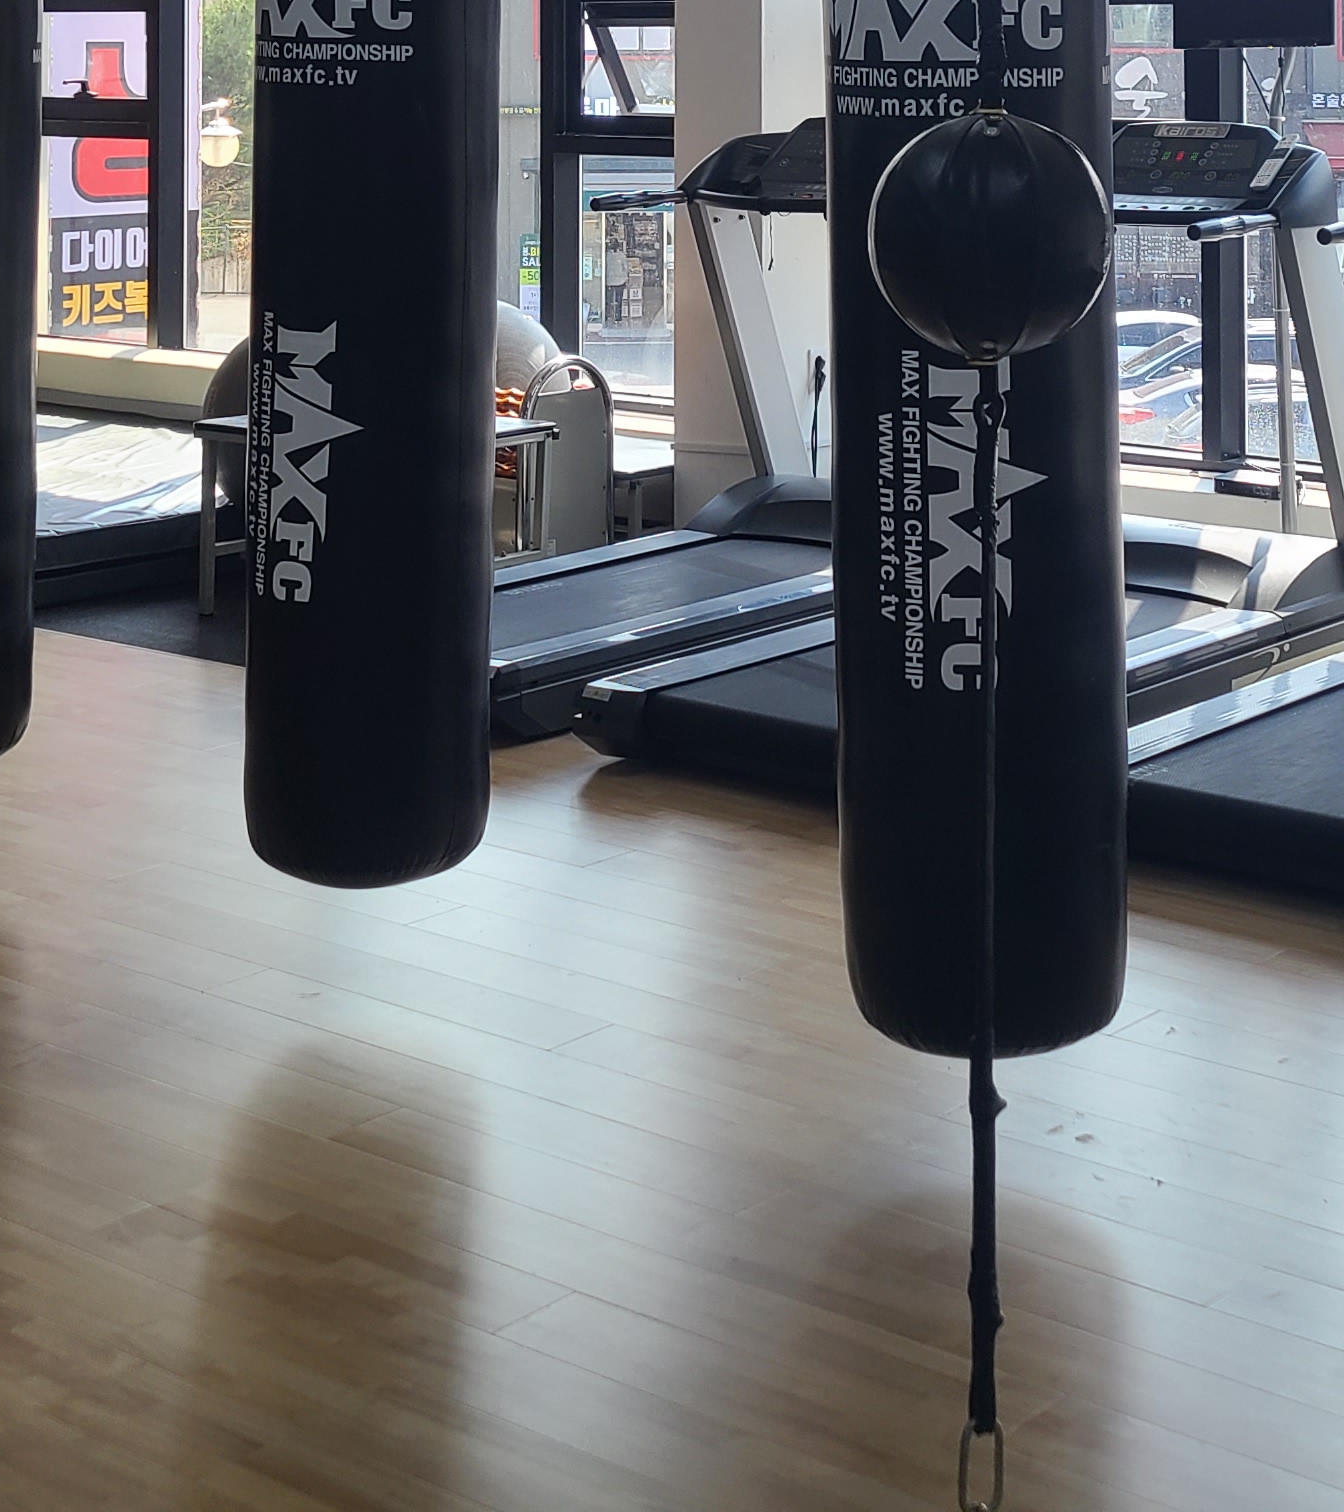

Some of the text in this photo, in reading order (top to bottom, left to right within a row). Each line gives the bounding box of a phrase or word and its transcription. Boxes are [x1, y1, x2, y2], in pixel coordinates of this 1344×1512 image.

[256, 40, 414, 62] TING CHAMPIONSHIP
[256, 63, 358, 86] w.maxfc.tv
[833, 65, 1064, 88] FIGHTING CHAMPNSHIP
[836, 92, 965, 118] www.maxfc
[61, 226, 148, 274] 다이어
[522, 256, 541, 267] SAL
[62, 279, 148, 327] 키즈복
[255, 311, 274, 597] MAX FIGHTING CHAMPIONSHIP
[269, 320, 365, 603] MAXFC
[877, 412, 900, 622] www.maxfc.tv
[901, 349, 925, 691] MAX FIGHTING CHAMPIONSHIP
